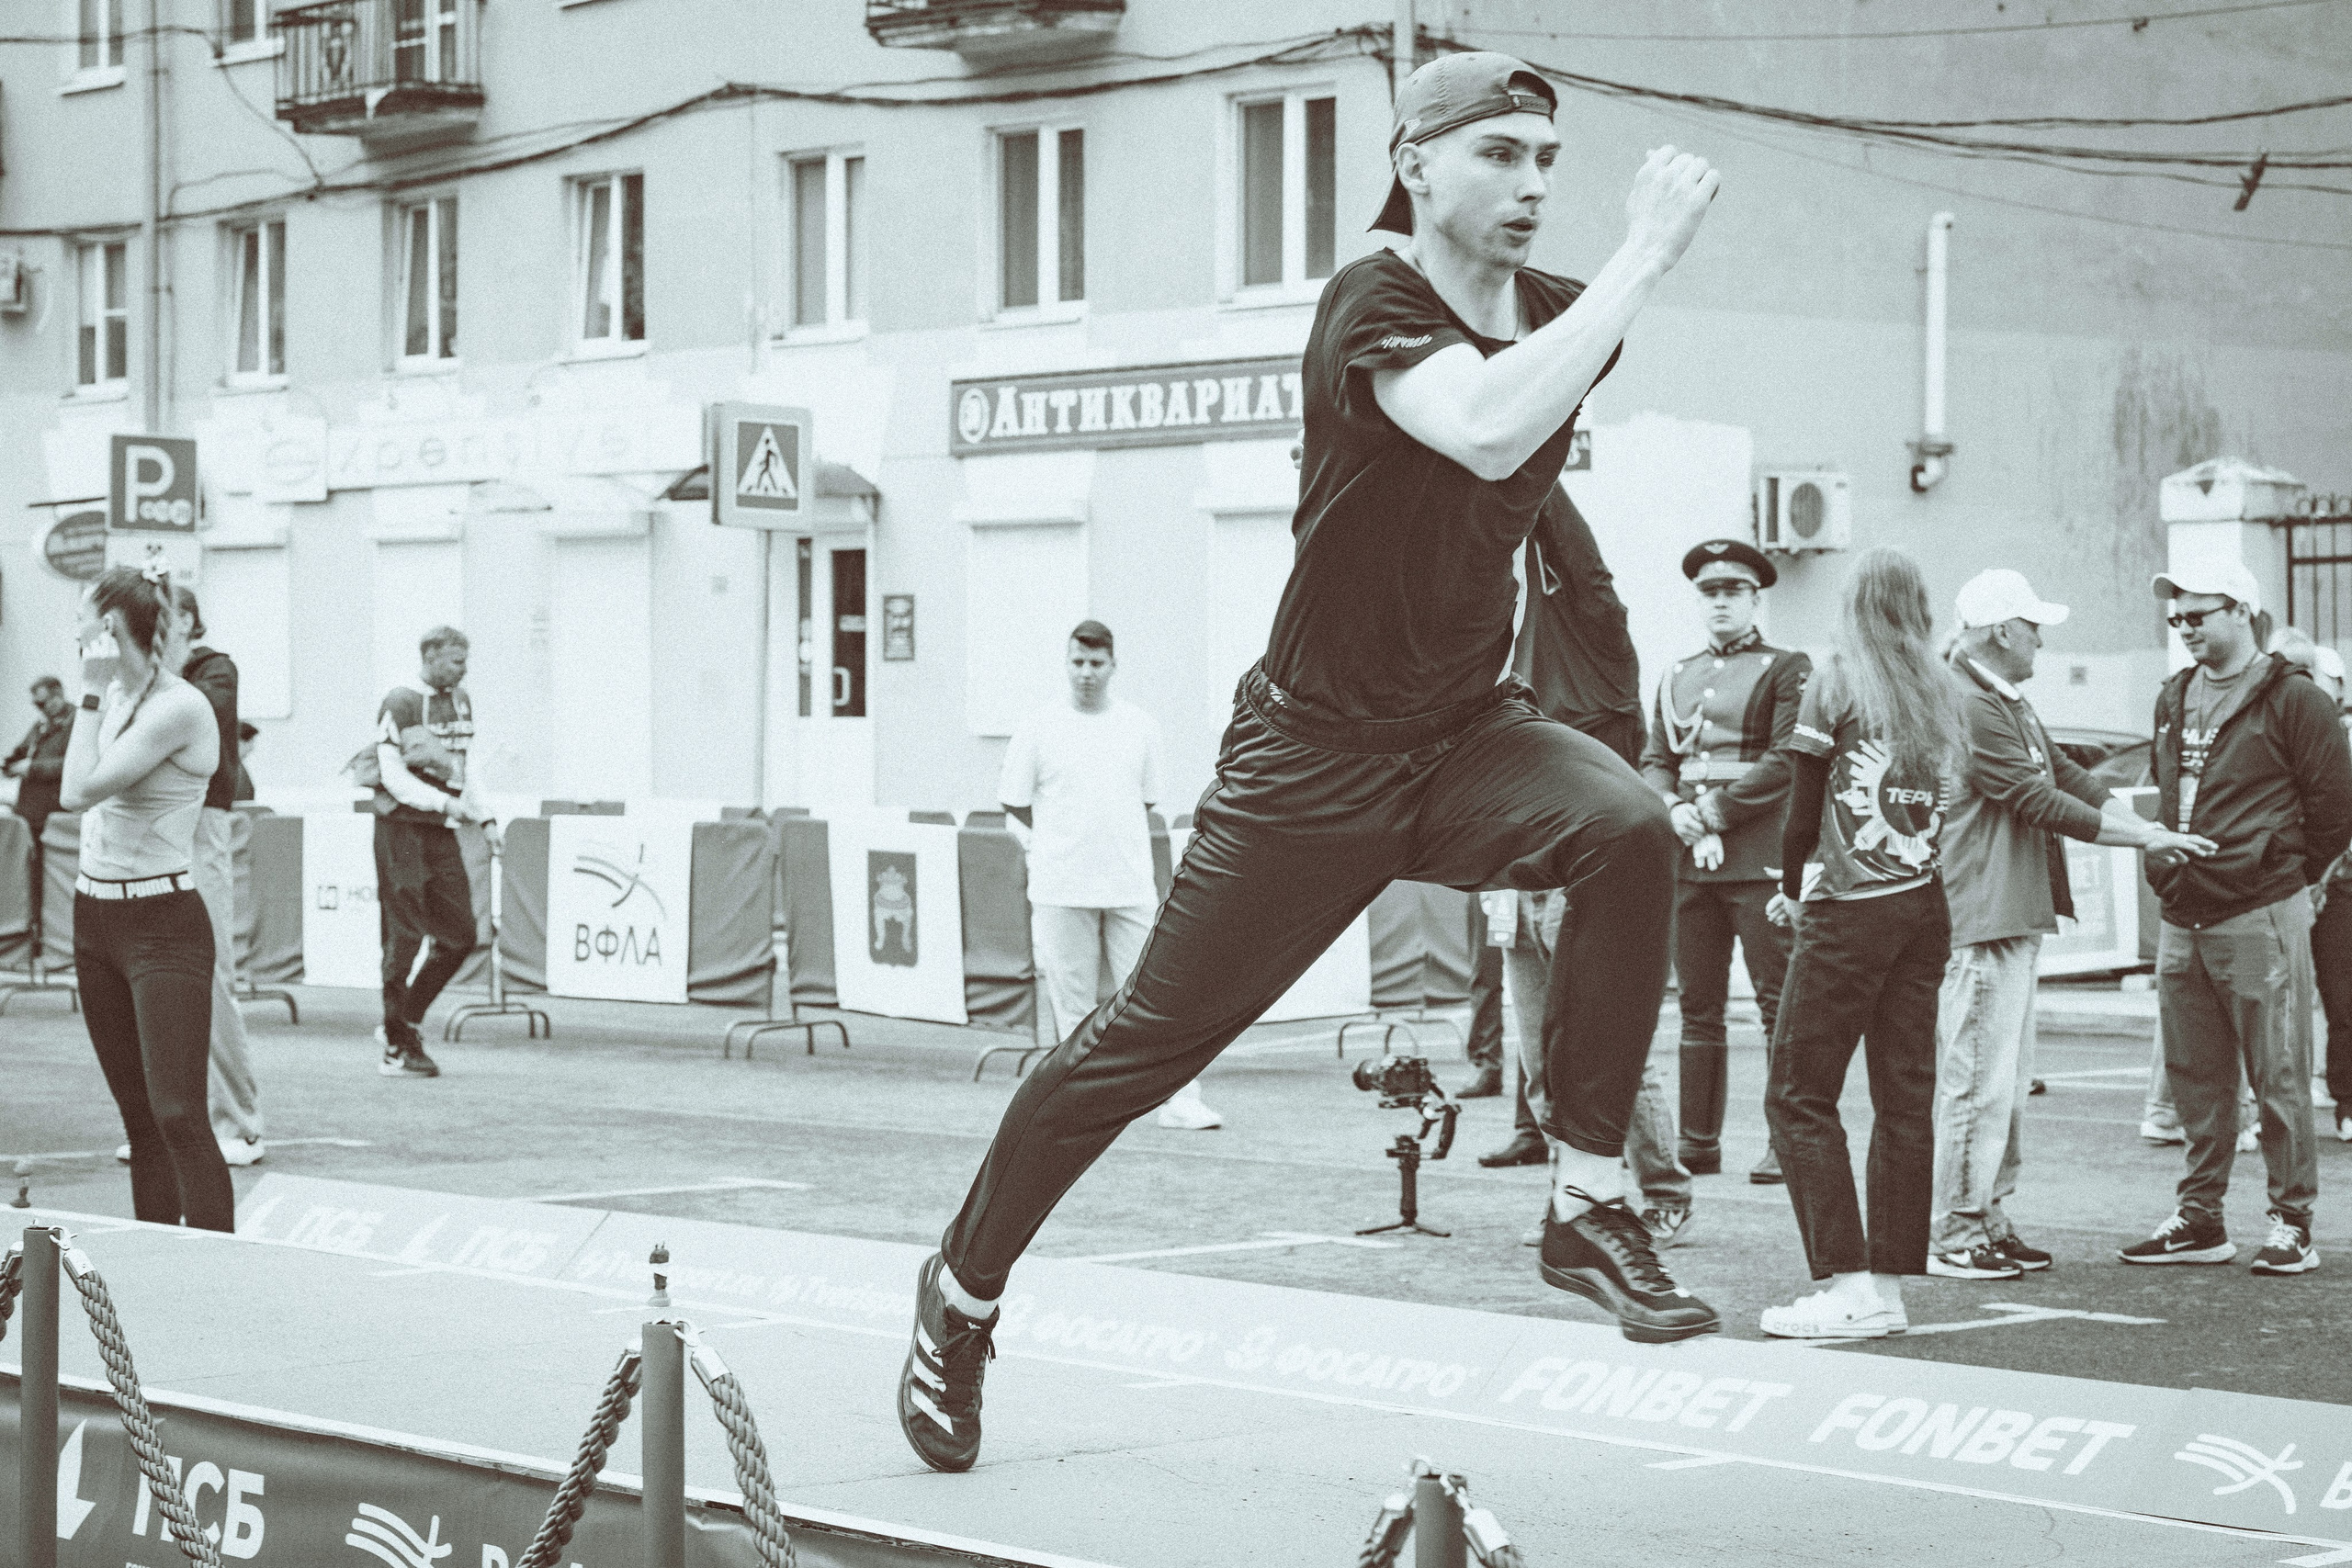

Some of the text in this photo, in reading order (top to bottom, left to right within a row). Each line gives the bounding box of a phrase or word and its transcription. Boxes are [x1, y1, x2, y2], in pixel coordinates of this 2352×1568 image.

[125, 446, 175, 522] P
[575, 923, 662, 965] ВФЛА
[451, 1224, 559, 1271] ПСБ
[1773, 1321, 1820, 1334] crocs
[1499, 1356, 1793, 1432] FONBET
[1808, 1393, 2137, 1475] FONBET
